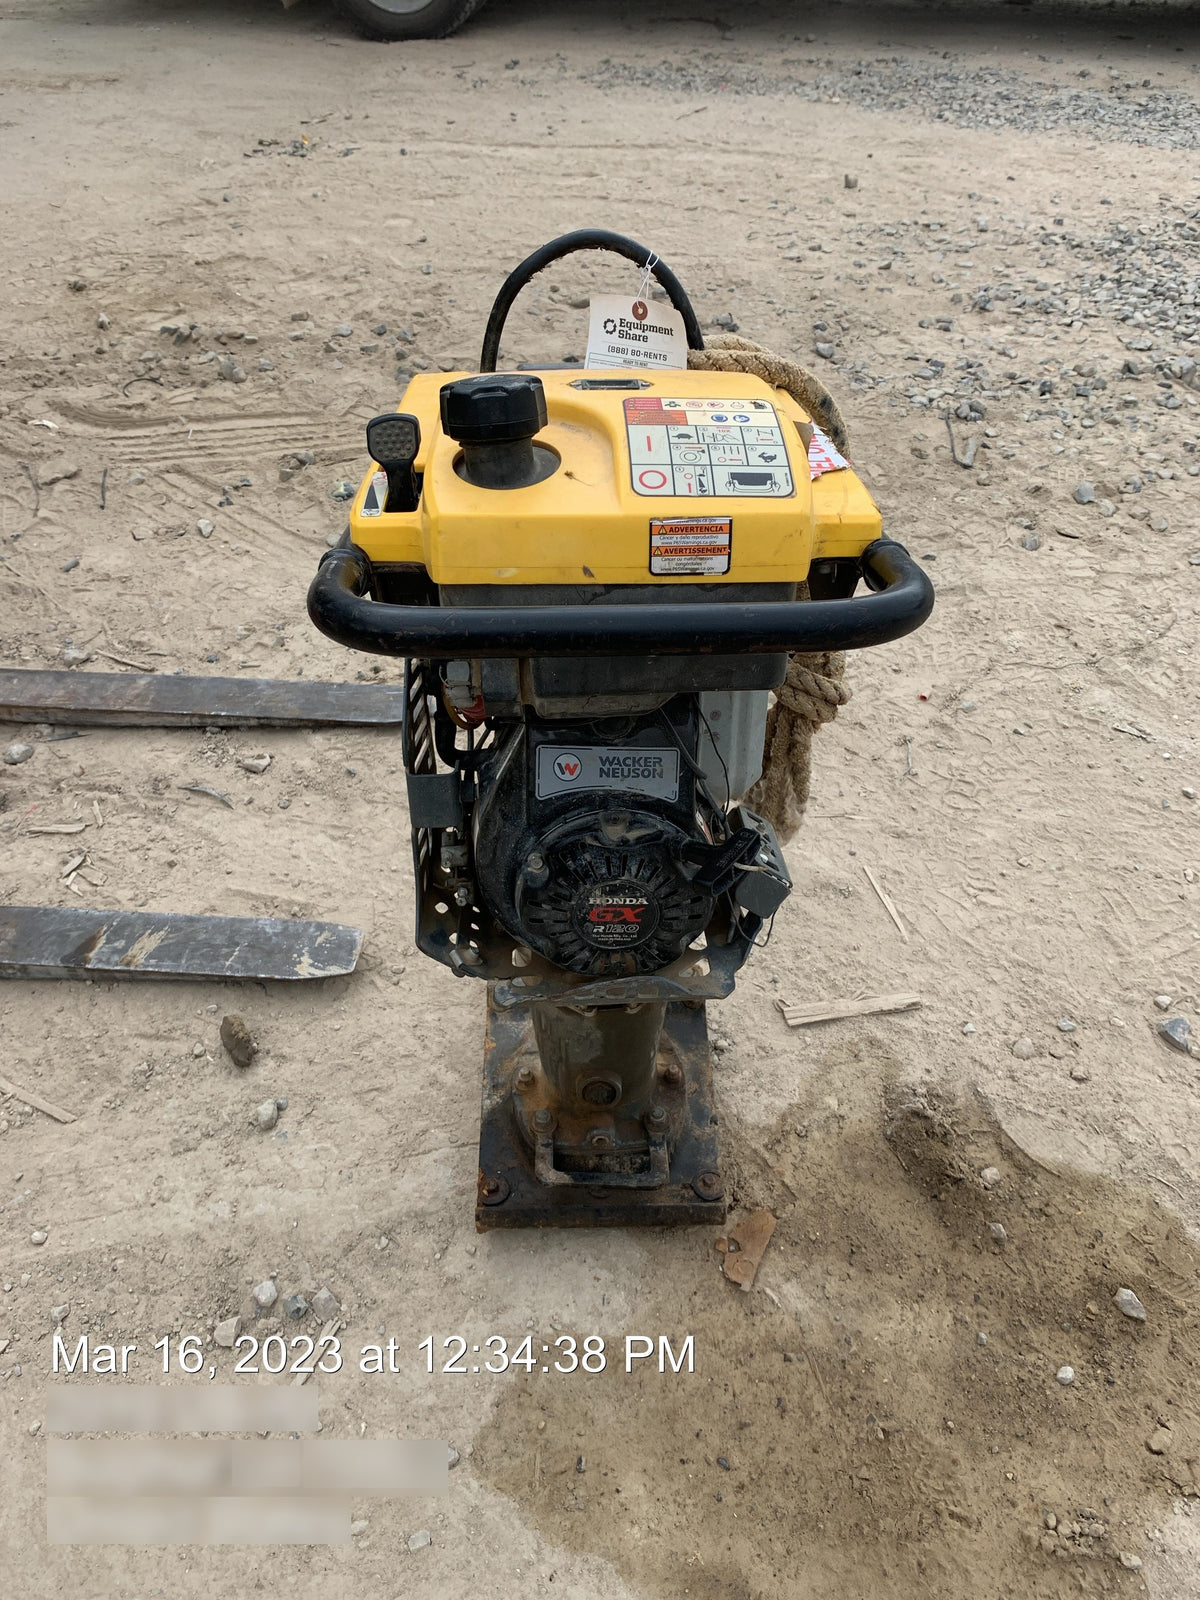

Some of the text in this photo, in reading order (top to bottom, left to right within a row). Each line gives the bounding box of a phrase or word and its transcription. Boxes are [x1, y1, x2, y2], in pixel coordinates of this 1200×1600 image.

[619, 318, 674, 336] Equipment
[618, 330, 649, 343] Share
[607, 344, 668, 362] (888) 80-RENTS
[669, 525, 724, 533] ADVERTENCIA
[664, 546, 728, 555] AVERTISSEMENT
[598, 756, 663, 767] WACKER
[599, 767, 664, 779] NEUSON
[588, 897, 649, 905] HONDA
[588, 907, 645, 922] GX
